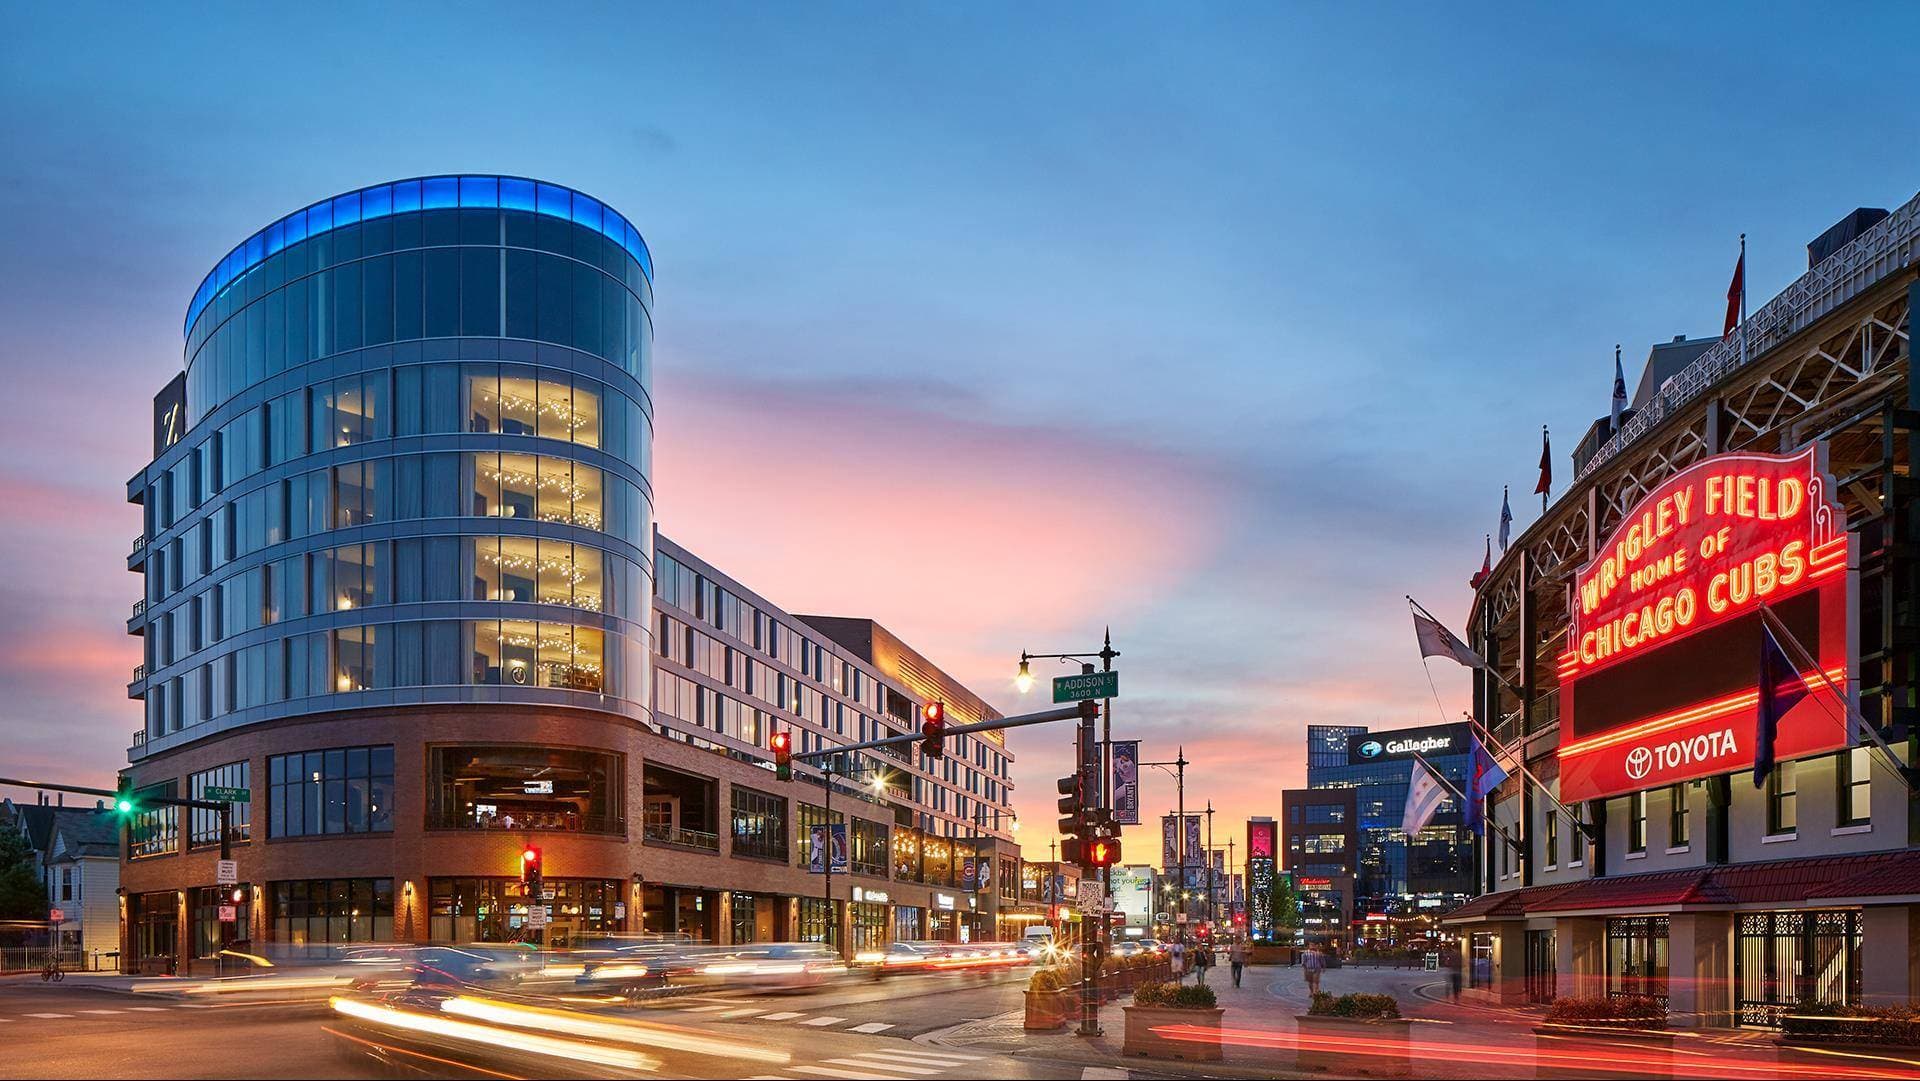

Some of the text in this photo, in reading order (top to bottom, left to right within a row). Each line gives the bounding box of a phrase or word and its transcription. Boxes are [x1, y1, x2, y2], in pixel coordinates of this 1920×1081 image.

[1580, 475, 1802, 615] WRIGLEY FIELD
[1630, 527, 1730, 592] HOME OF
[1580, 540, 1804, 664] CHICAGO CUBS
[1064, 676, 1104, 690] ADDISON
[1070, 690, 1091, 698] 3600
[1386, 737, 1451, 753] Gallagher
[1655, 729, 1738, 770] TOYOTA
[1126, 786, 1135, 810] BRYANT
